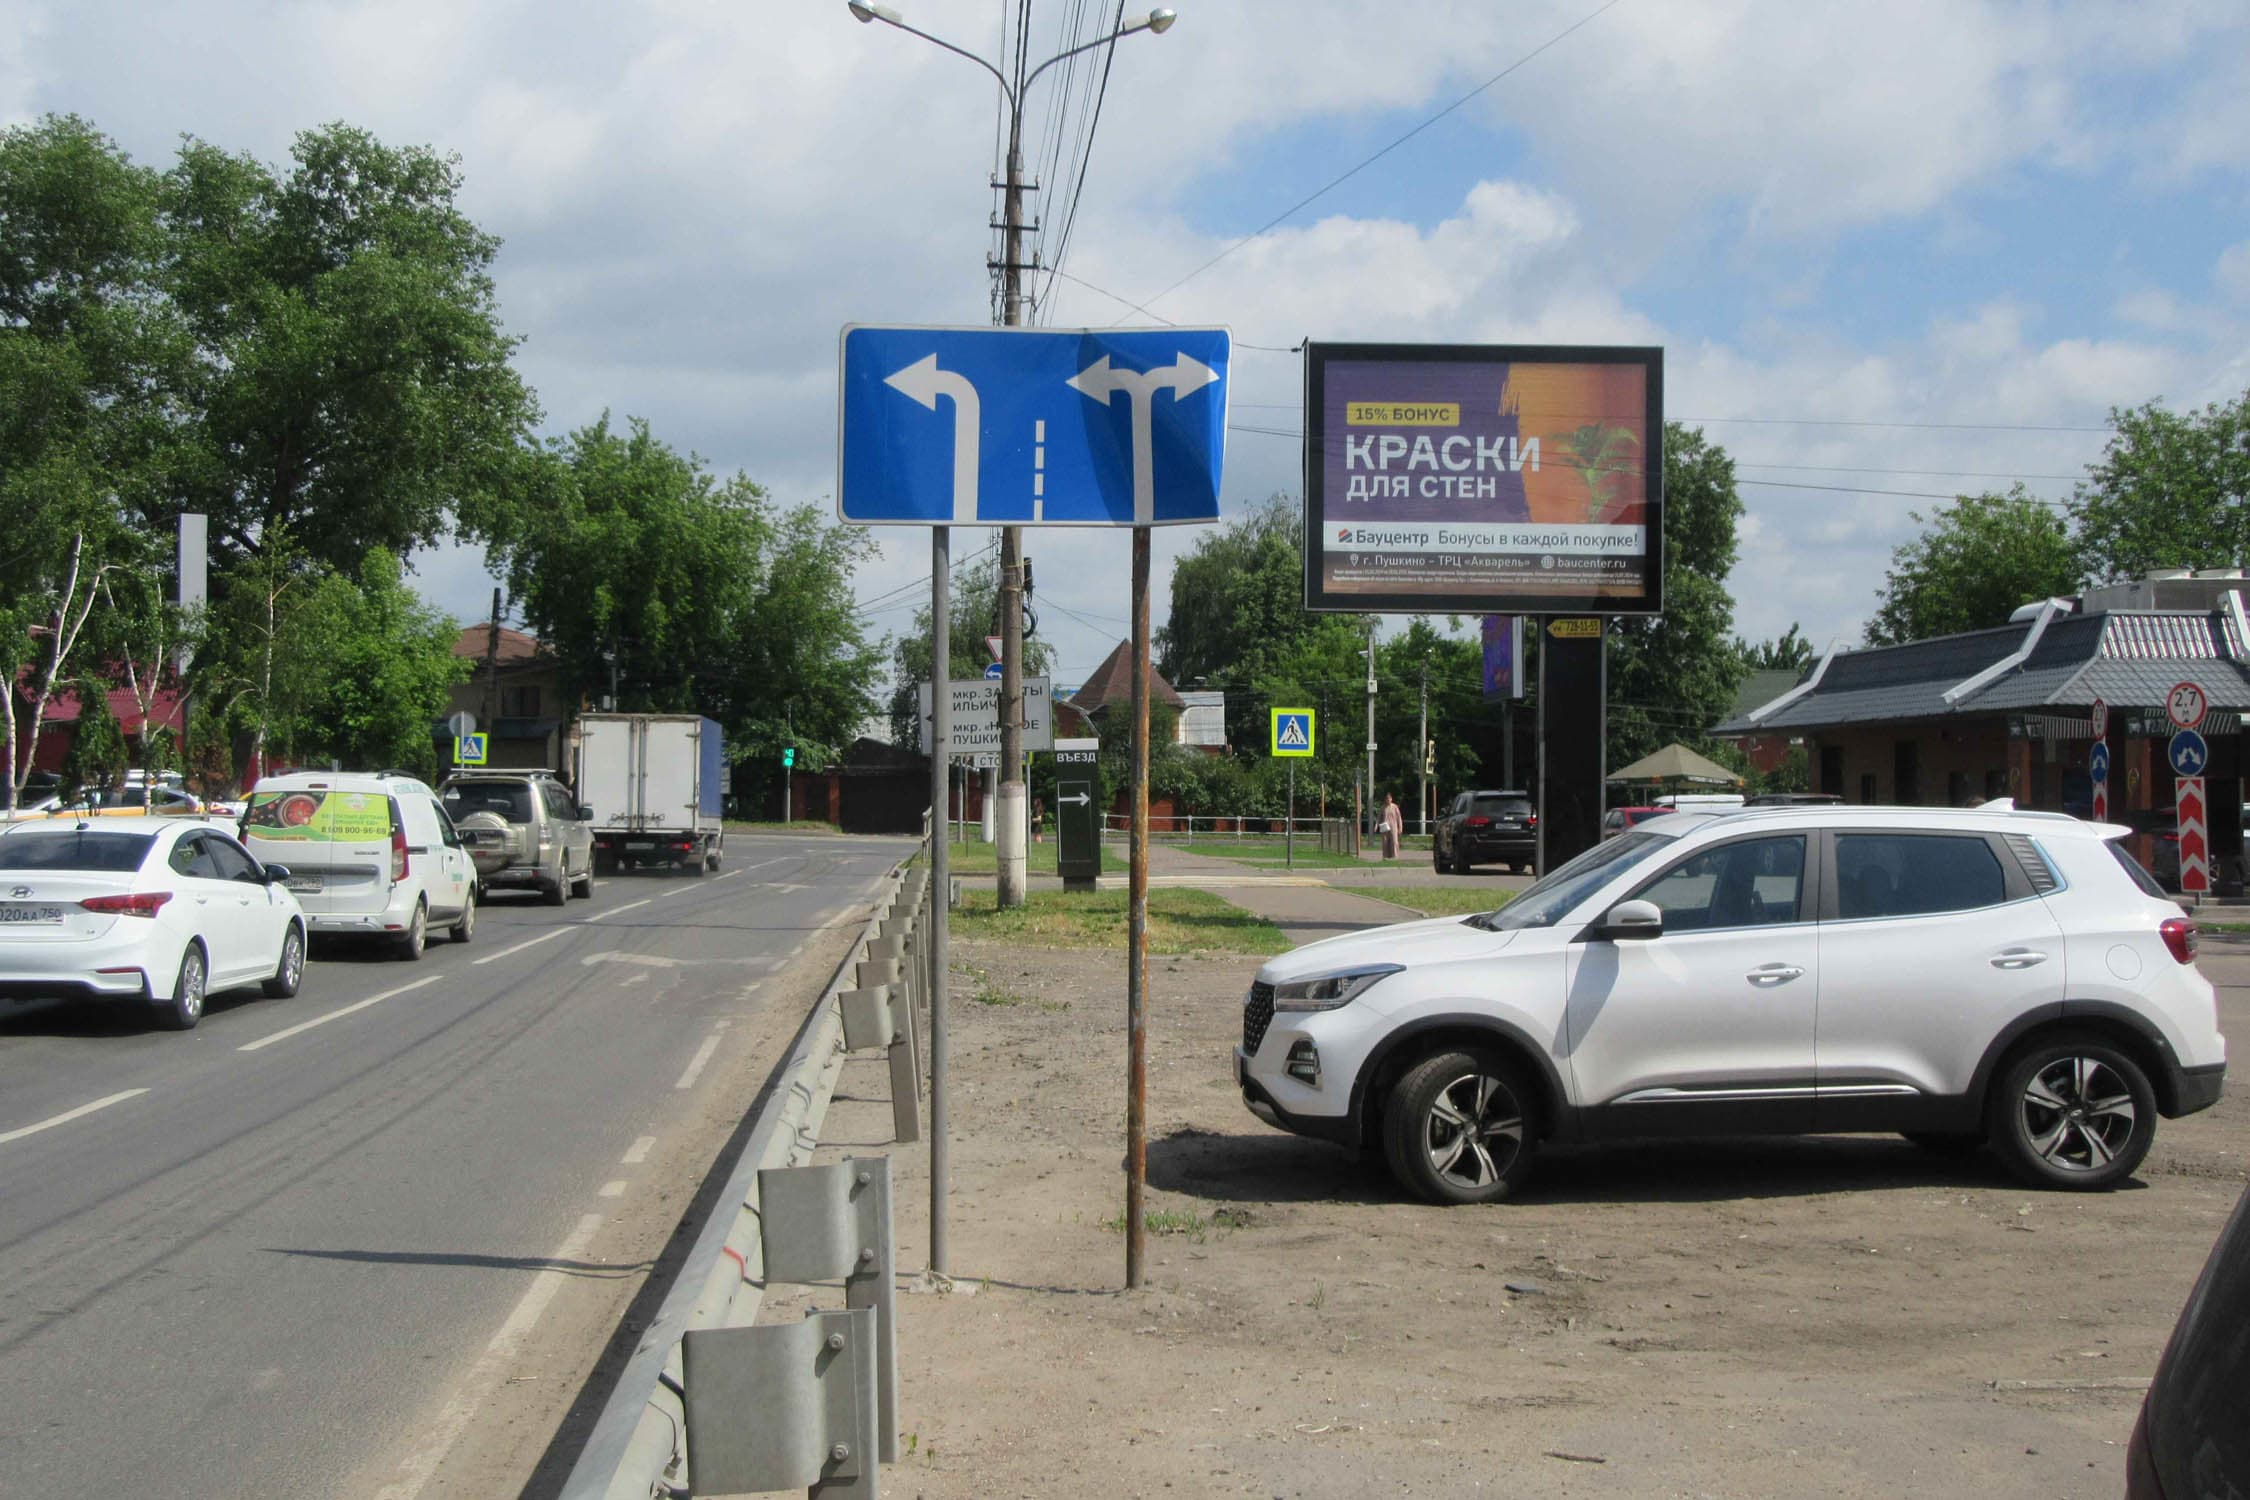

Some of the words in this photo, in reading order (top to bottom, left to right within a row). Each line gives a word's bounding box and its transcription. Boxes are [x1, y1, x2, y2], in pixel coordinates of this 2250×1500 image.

[1355, 407, 1388, 421] 15%
[1392, 407, 1450, 421] БОНУС
[1346, 434, 1540, 473] КРАСКИ
[1346, 475, 1410, 502] ДЛЯ
[1419, 476, 1496, 498] СТЕН
[1356, 530, 1429, 546] Бауцентр
[1438, 530, 1495, 548] Бонусы
[1499, 535, 1508, 545] в
[1513, 532, 1569, 548] каждой
[1573, 533, 1638, 550] покупке!
[1375, 556, 1426, 568] Пушкино
[1438, 556, 1462, 568] ТРЦ
[1557, 558, 1627, 570] baucenter.ru
[984, 685, 1043, 698] ЗАТЫ
[952, 700, 998, 712] ИЛЬИЧ
[952, 734, 1002, 745] ПУШКИ
[1056, 752, 1097, 764] ВЪЕЗД
